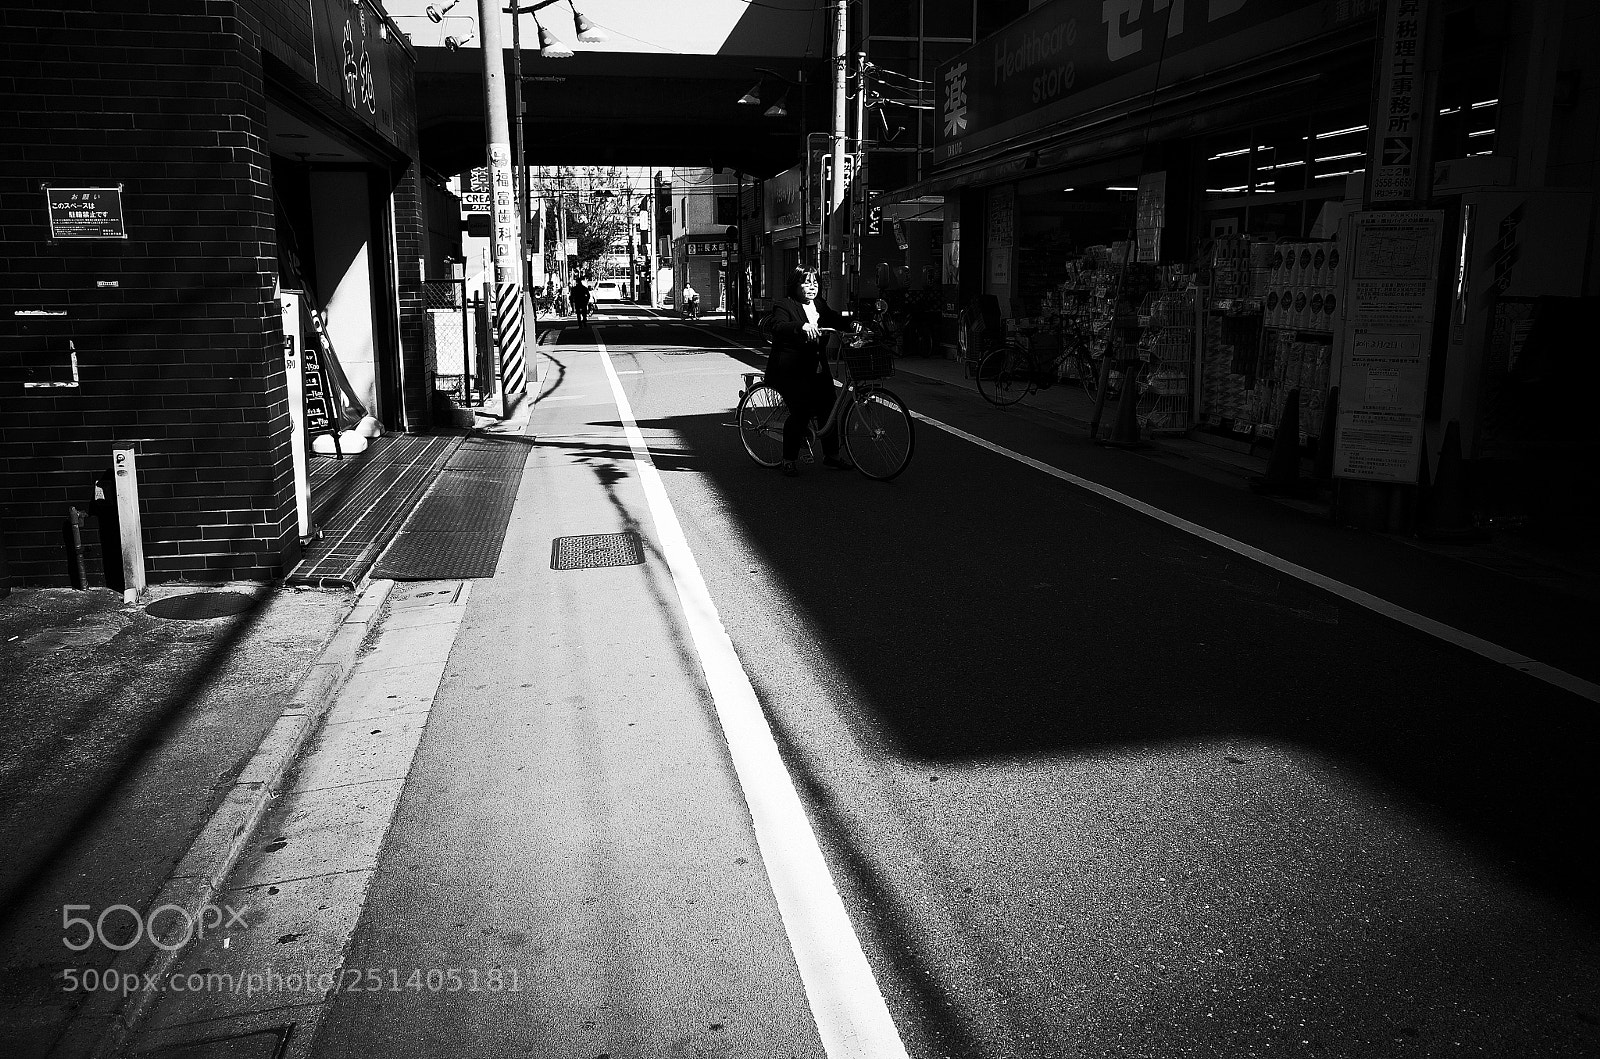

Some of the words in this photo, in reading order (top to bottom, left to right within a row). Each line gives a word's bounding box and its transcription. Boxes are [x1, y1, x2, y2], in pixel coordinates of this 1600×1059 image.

[994, 18, 1077, 87] Healthcare
[1032, 61, 1075, 103] store
[944, 62, 968, 137] 薬
[496, 170, 512, 241] 福富歯科
